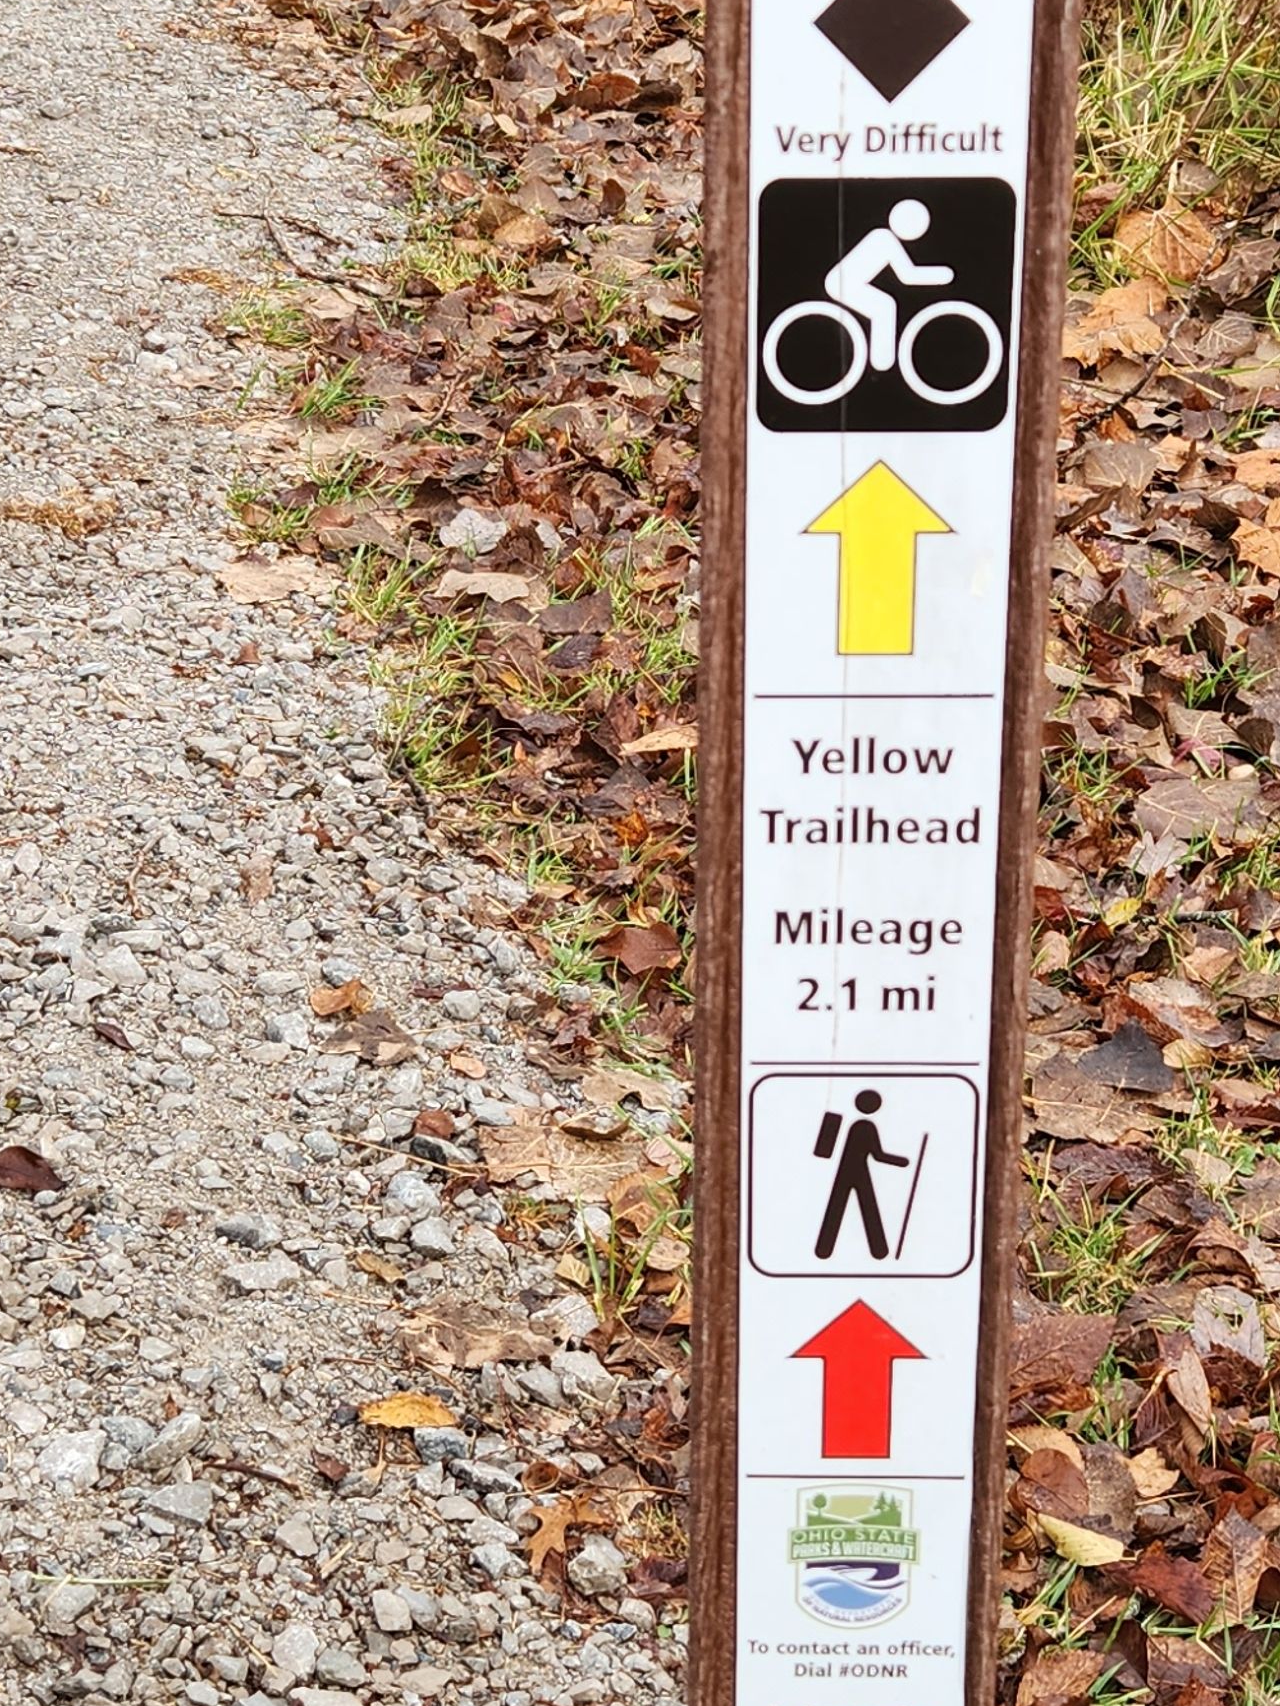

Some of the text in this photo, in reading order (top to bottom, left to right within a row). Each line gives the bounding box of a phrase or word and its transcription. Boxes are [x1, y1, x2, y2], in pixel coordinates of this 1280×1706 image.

[775, 124, 1004, 161] Very Difficult
[792, 737, 954, 774] Yellow
[760, 807, 981, 844] Trailhead
[774, 909, 963, 954] Mileage
[797, 975, 935, 1011] 2.1 mi
[792, 1527, 916, 1545] OHIO STATE
[748, 1640, 955, 1658] To contact an officer,
[794, 1663, 908, 1678] Dial #ODNR
